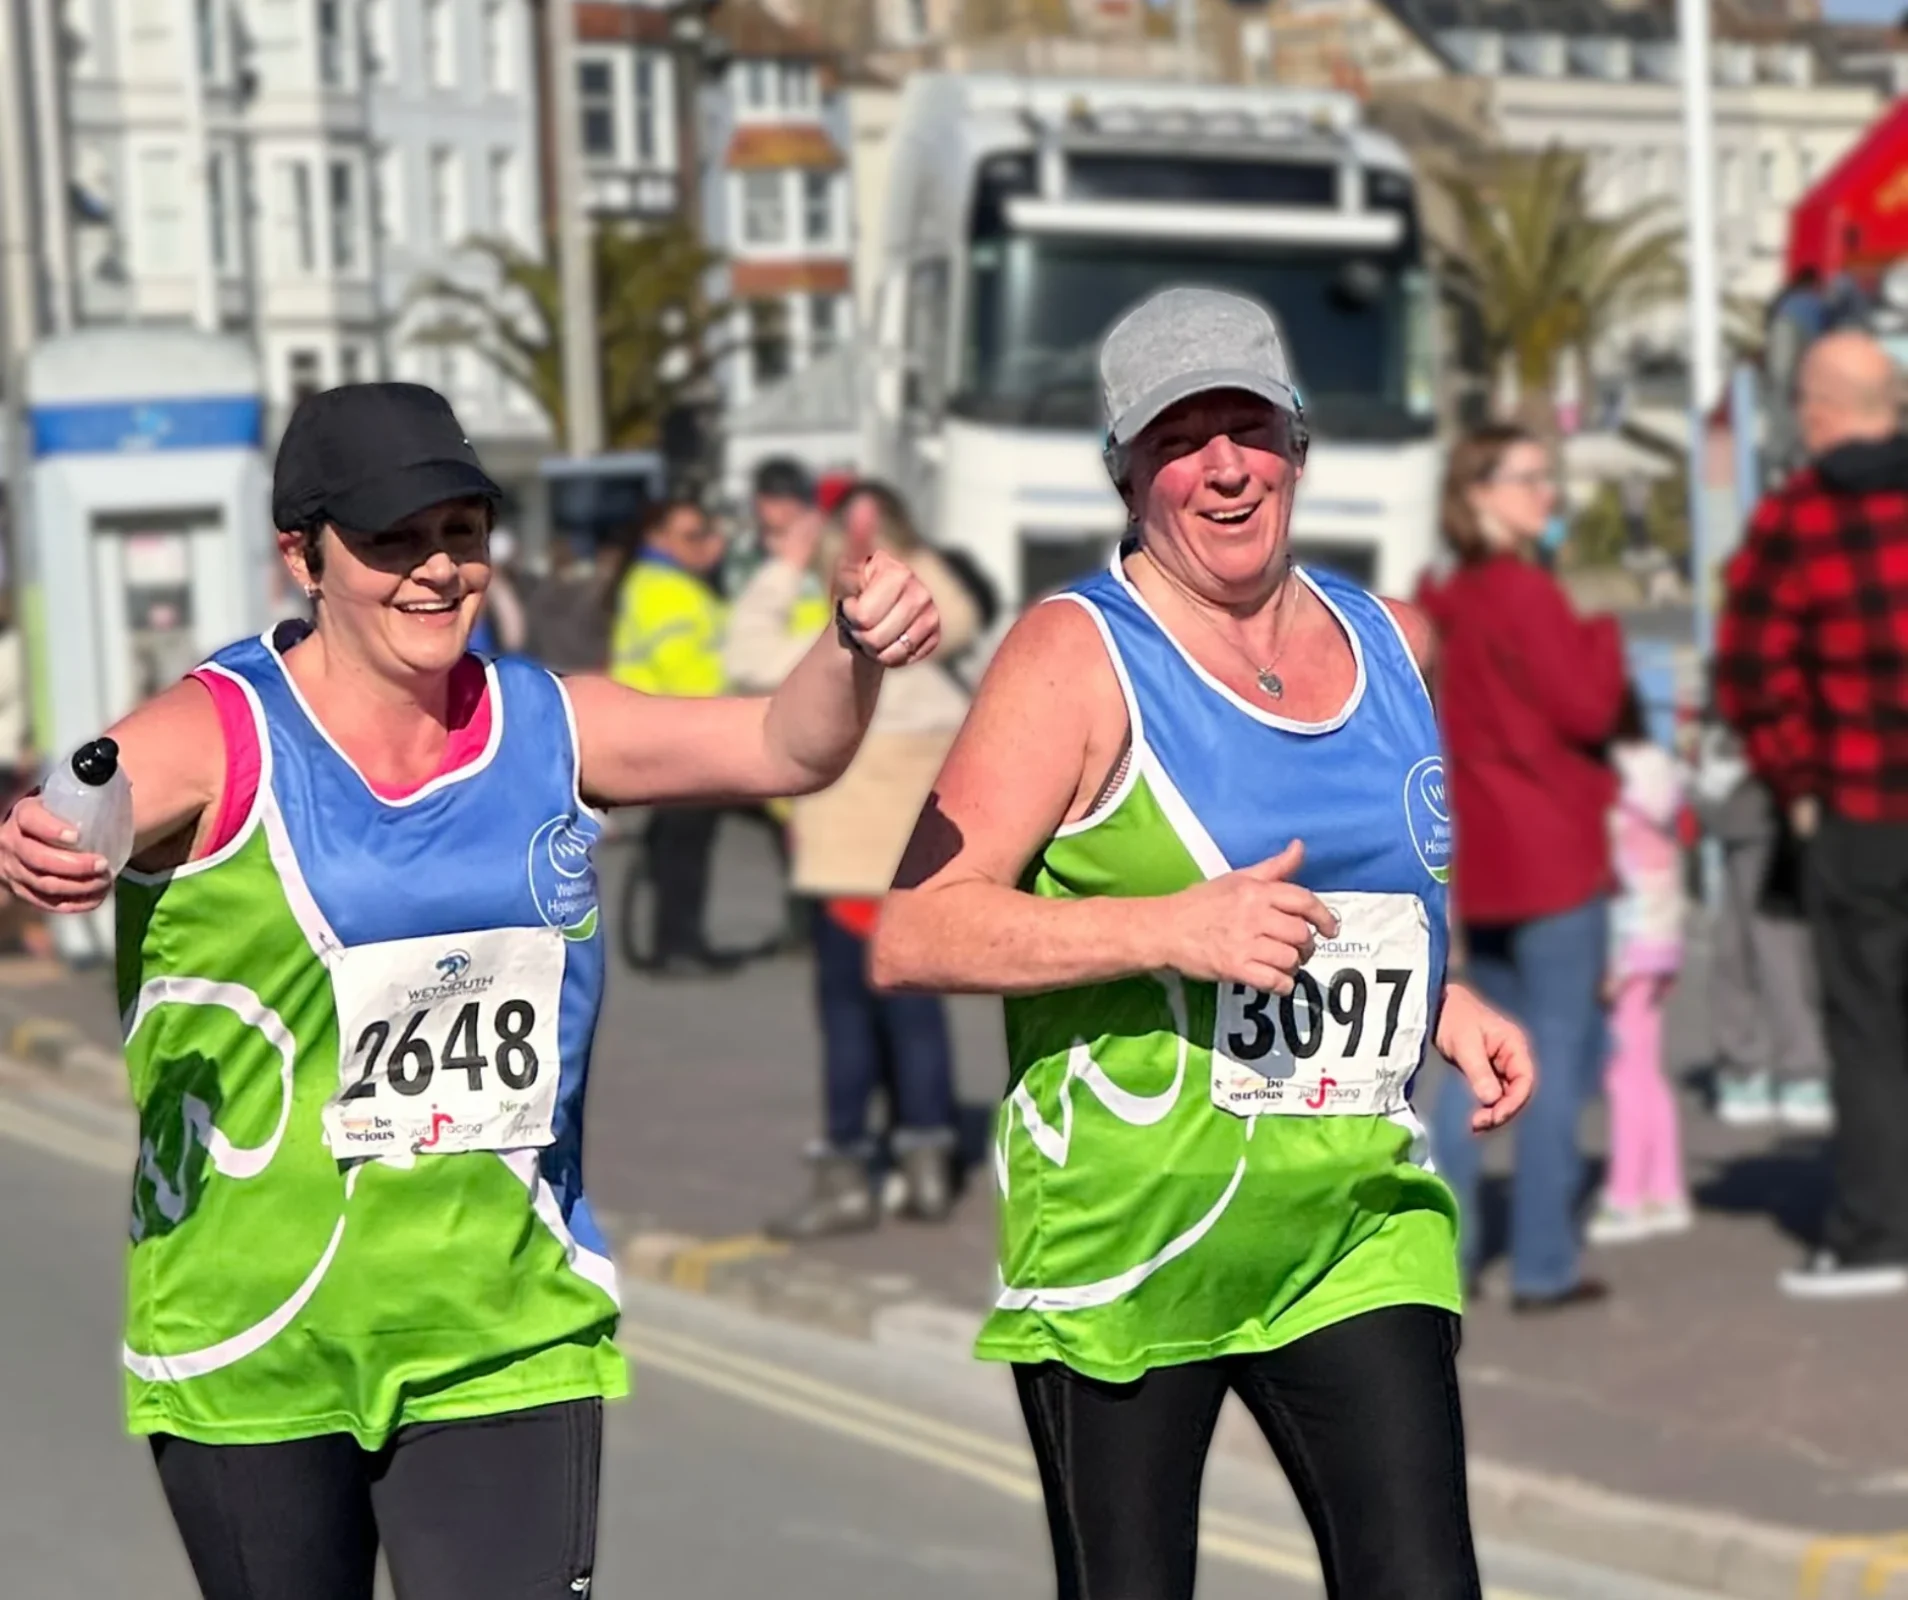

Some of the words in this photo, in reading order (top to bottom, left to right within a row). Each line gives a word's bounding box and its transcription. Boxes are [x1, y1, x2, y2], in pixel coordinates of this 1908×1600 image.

[407, 975, 495, 1000] WEYMOUTH
[1227, 967, 1414, 1061] 3097
[337, 998, 540, 1107] 2648
[374, 1116, 393, 1129] be
[409, 1125, 431, 1139] just
[440, 1122, 484, 1136] racing
